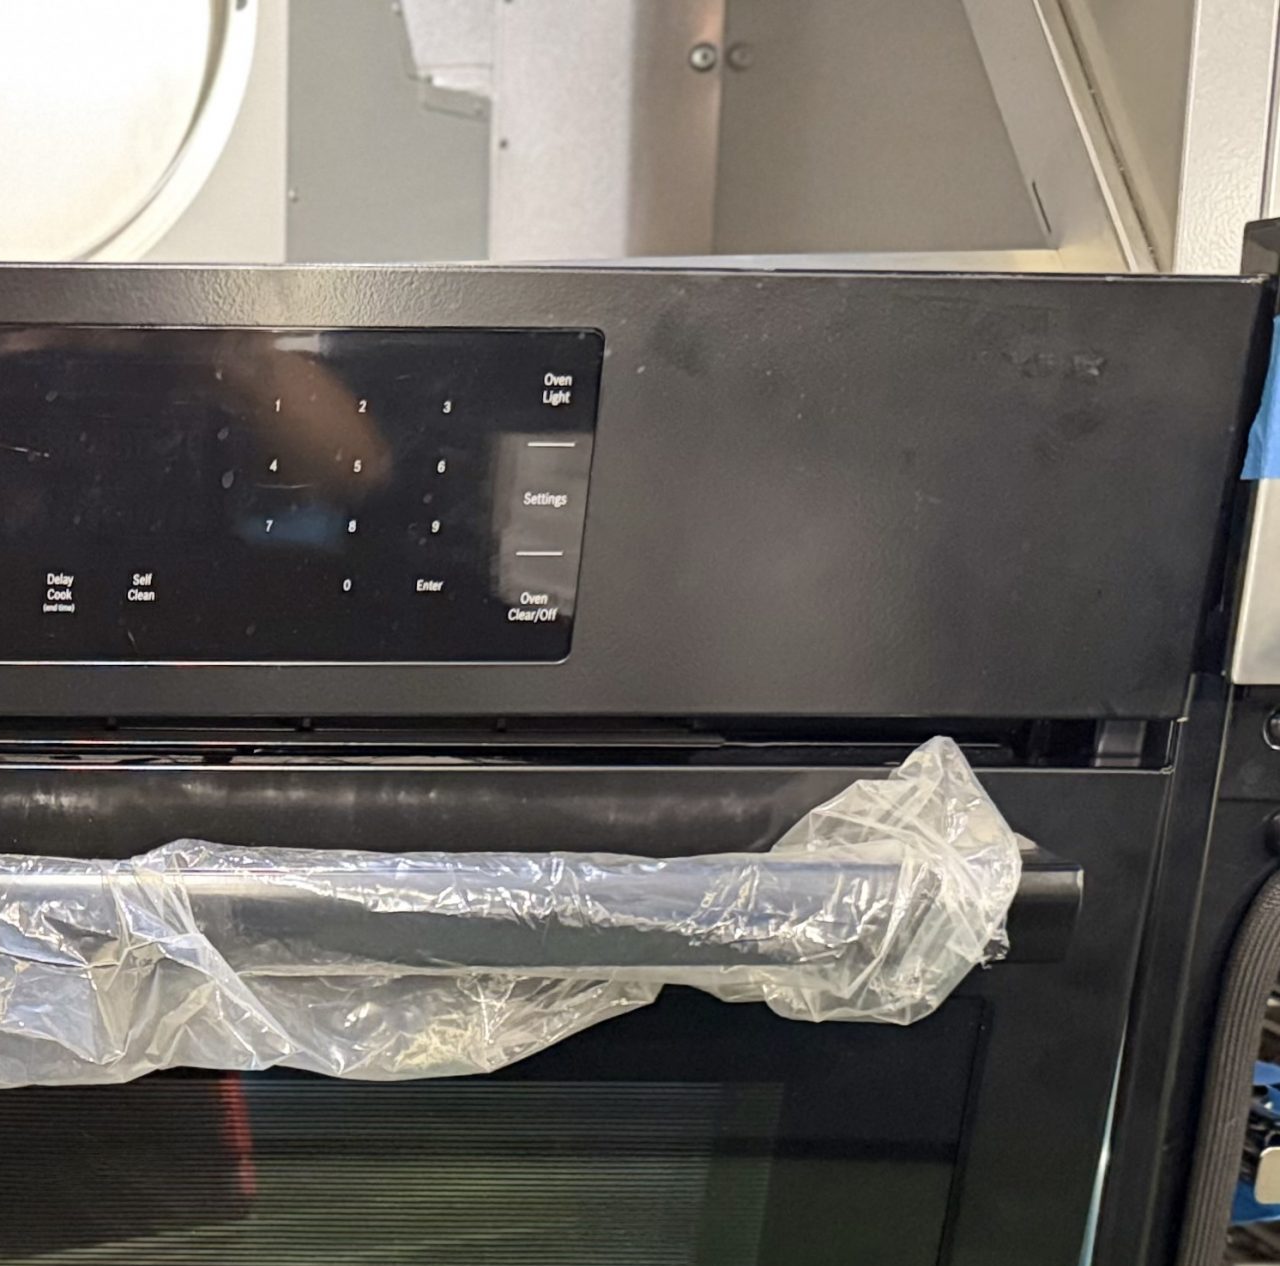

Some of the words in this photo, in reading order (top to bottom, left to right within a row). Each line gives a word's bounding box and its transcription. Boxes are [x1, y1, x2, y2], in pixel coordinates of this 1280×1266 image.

[543, 372, 573, 387] Oven
[542, 389, 571, 407] Light
[274, 398, 281, 412] 1
[358, 399, 367, 413] 2
[442, 400, 452, 414] 3
[269, 458, 278, 472] 4
[353, 459, 362, 473] 5
[437, 459, 446, 474] 6
[523, 491, 568, 508] Settings
[265, 519, 274, 533] 7
[347, 519, 357, 533] 8
[431, 519, 441, 533] 9
[46, 572, 75, 588] Delay
[132, 572, 153, 586] Self
[342, 578, 352, 592] 0
[416, 578, 444, 592] Enter
[46, 587, 73, 601] Cook
[127, 588, 156, 602] Clean
[520, 591, 549, 605] Oven
[507, 606, 559, 624] Clear/Off
